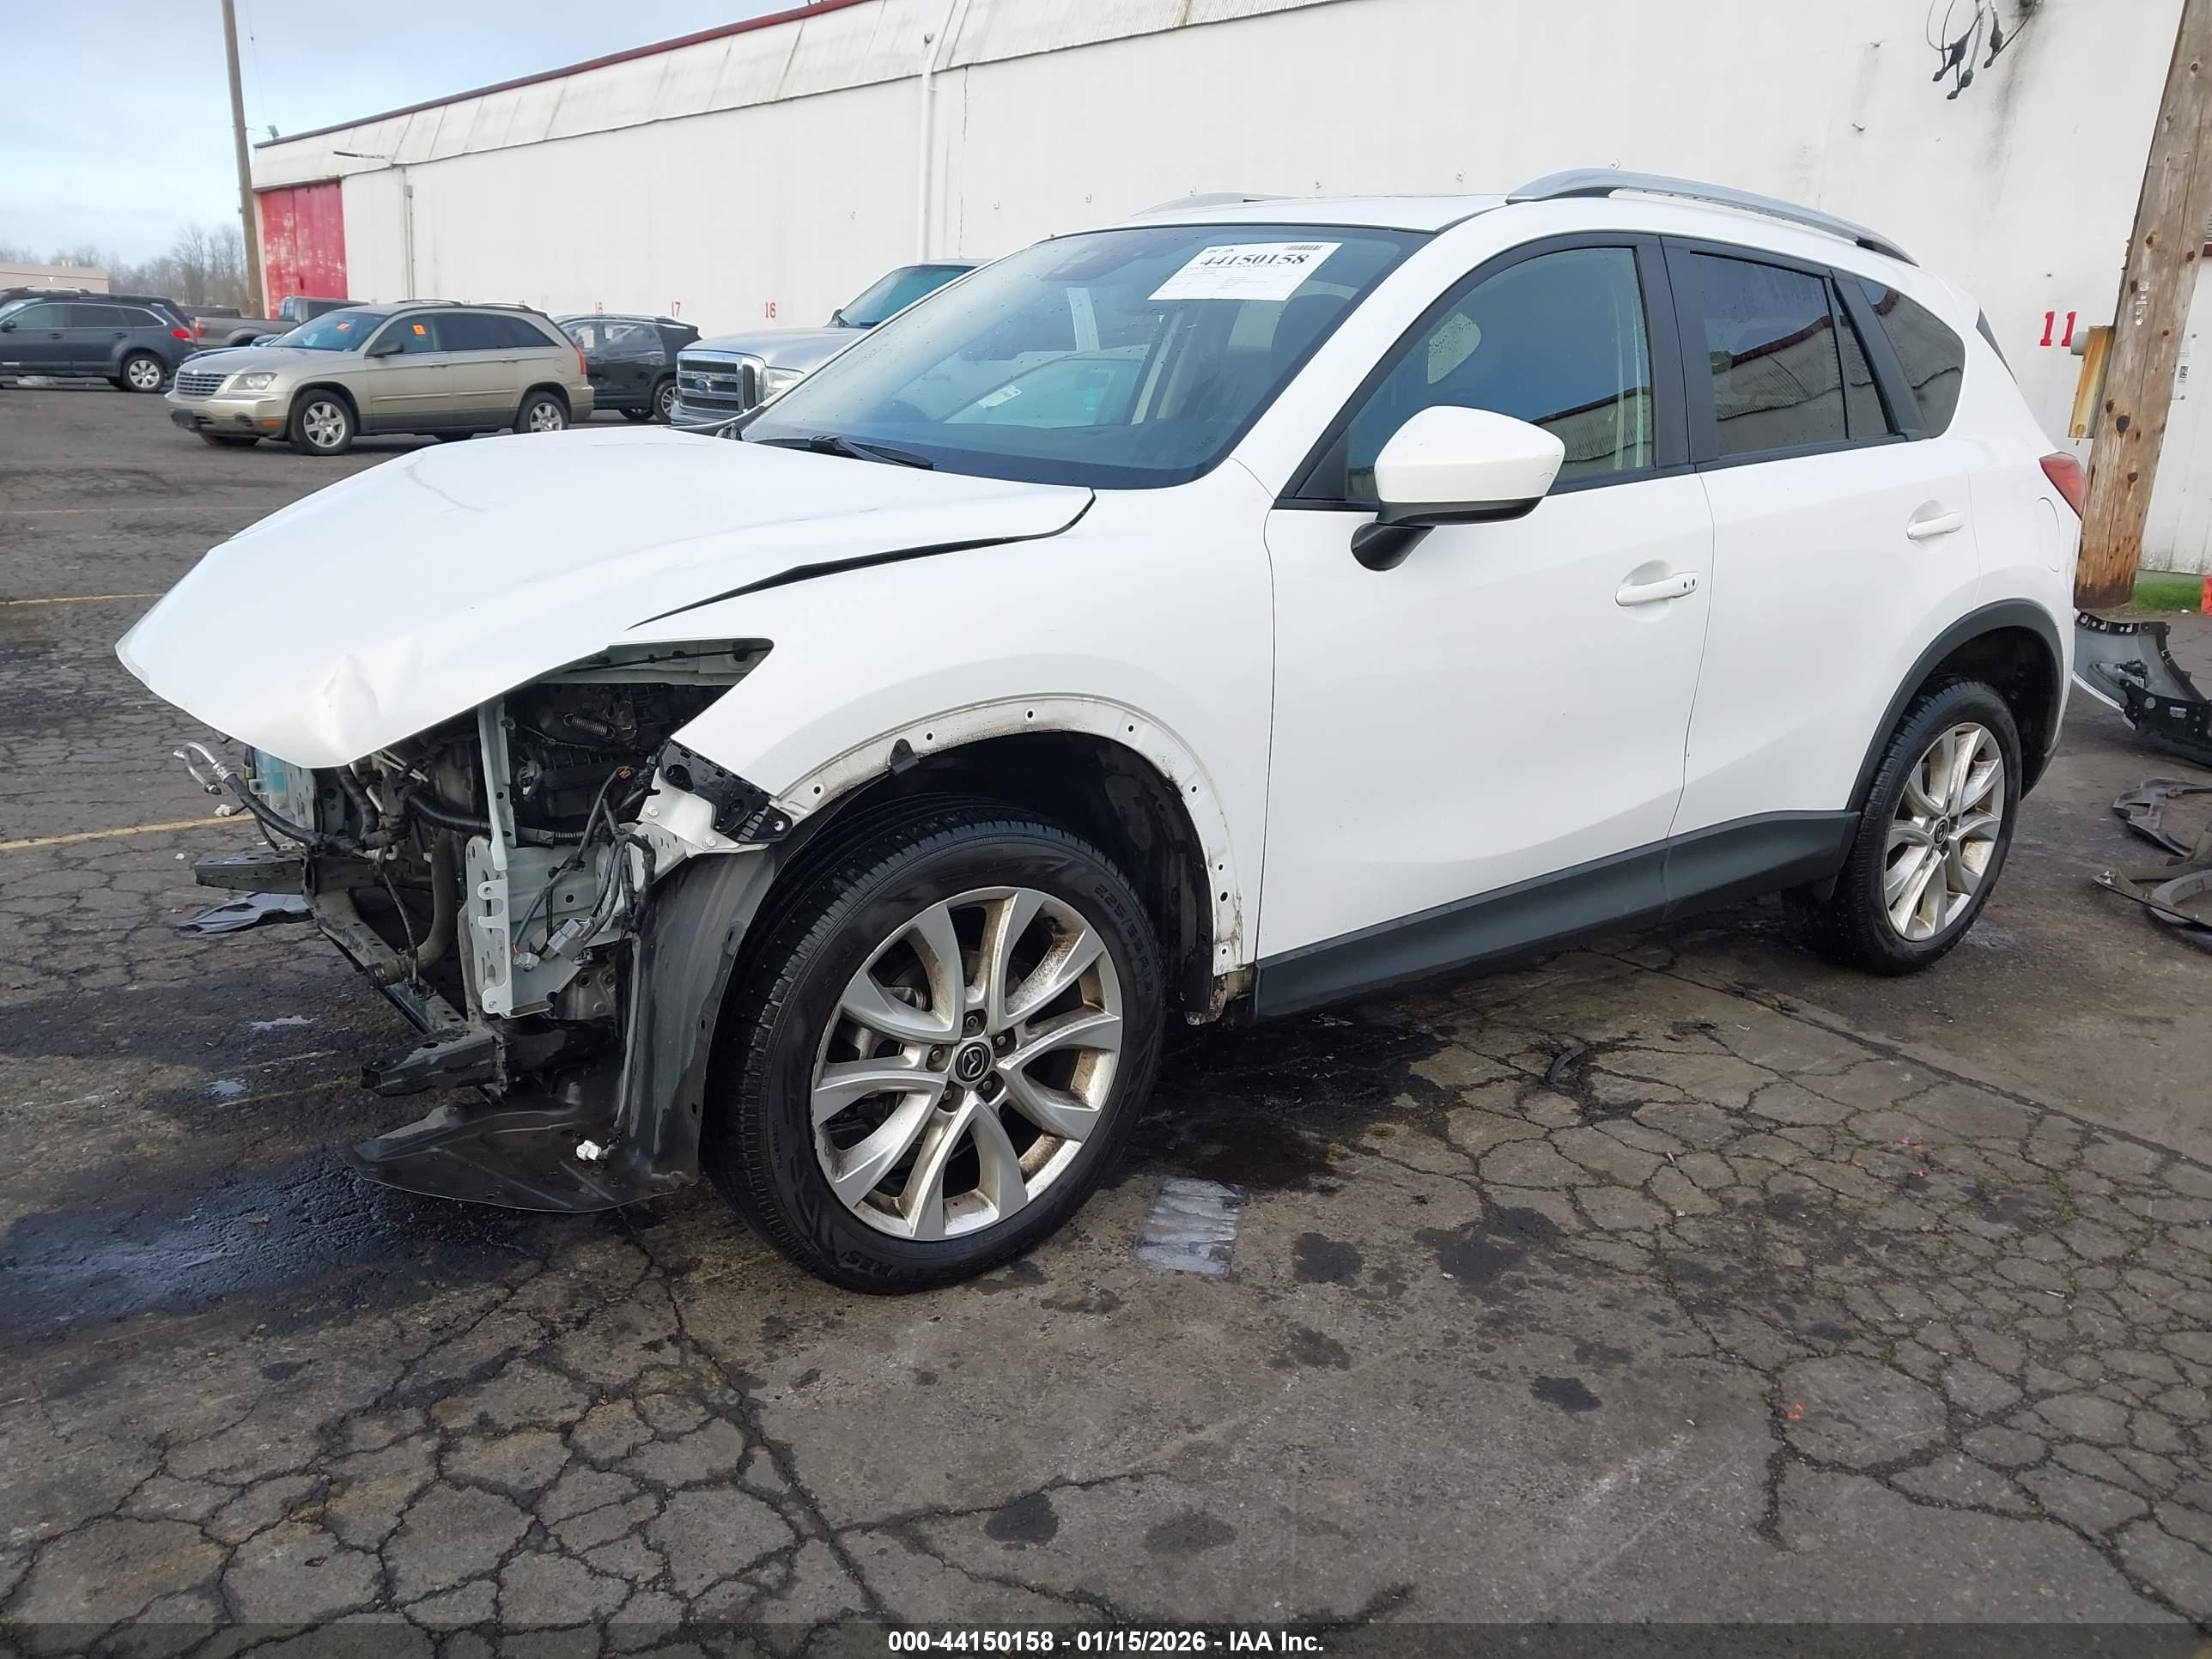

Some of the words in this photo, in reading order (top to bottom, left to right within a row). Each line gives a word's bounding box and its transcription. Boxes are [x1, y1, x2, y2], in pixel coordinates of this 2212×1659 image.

[1200, 254, 1310, 266] 44150158
[671, 301, 681, 317] 17
[765, 301, 776, 319] 16
[2039, 311, 2077, 347] 11
